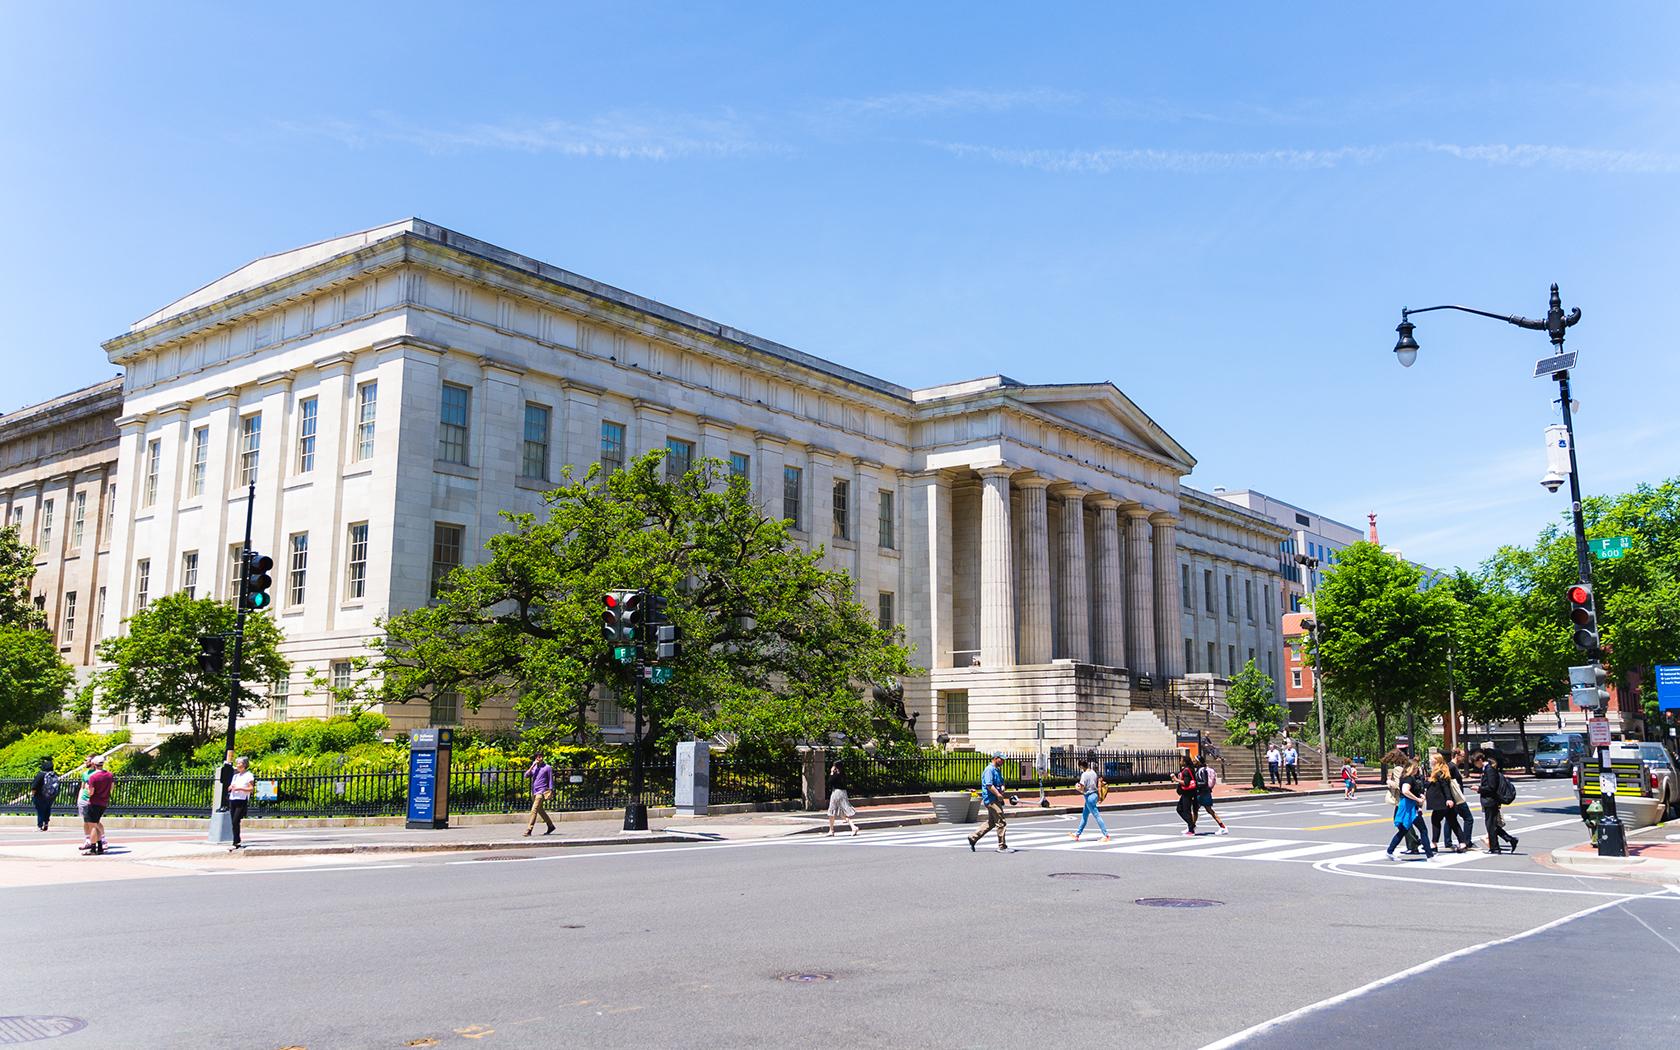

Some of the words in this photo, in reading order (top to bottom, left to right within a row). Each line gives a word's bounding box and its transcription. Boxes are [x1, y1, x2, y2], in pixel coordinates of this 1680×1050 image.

[1602, 539, 1610, 549] F
[1602, 549, 1619, 557] 600
[620, 648, 626, 657] F
[655, 668, 662, 677] 7
